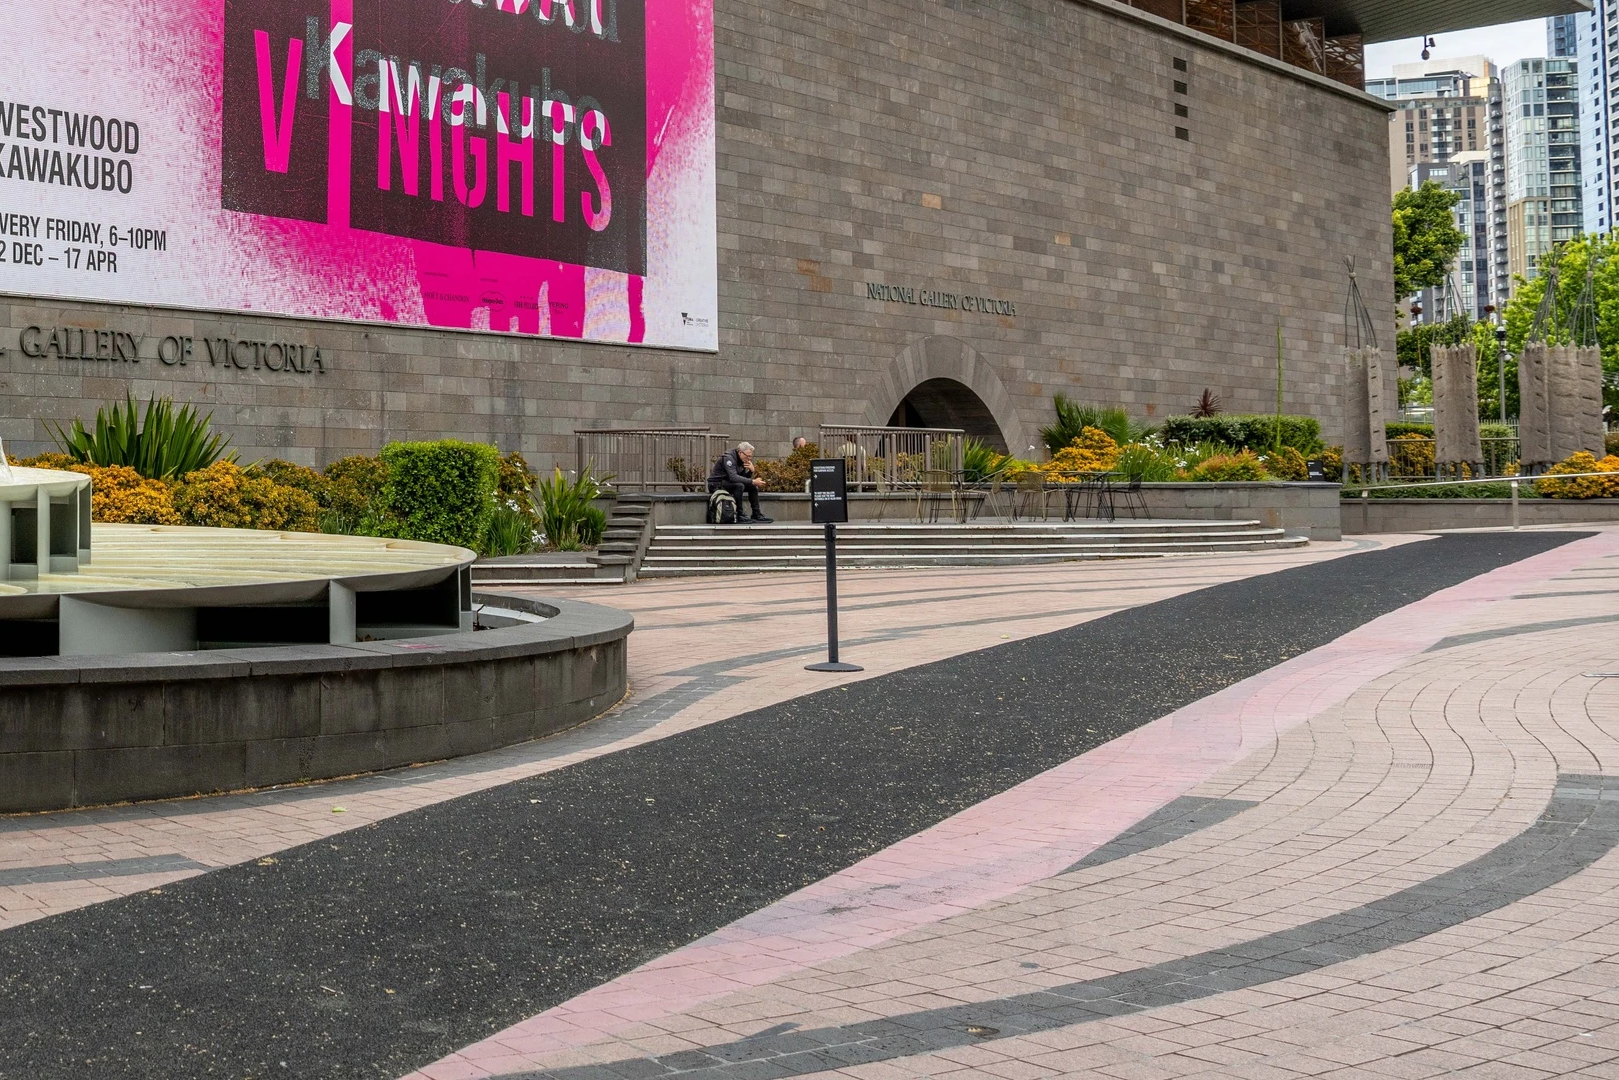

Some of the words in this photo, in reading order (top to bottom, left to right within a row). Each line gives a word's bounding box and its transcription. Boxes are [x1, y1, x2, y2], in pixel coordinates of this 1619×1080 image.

[305, 16, 606, 151] Kawakubo
[377, 58, 612, 232] NIGHTS
[46, 217, 104, 248] FRIDAY,
[12, 241, 43, 267] DEC
[63, 246, 81, 269] 17
[86, 249, 118, 273] APR
[867, 282, 916, 304] NATIONAL
[919, 289, 958, 310] GALLERY
[961, 295, 974, 312] OF
[975, 296, 1016, 317] VICTORIA
[19, 324, 145, 364] GALLERY
[157, 333, 193, 366] OF
[202, 336, 325, 374] VICTORIA
